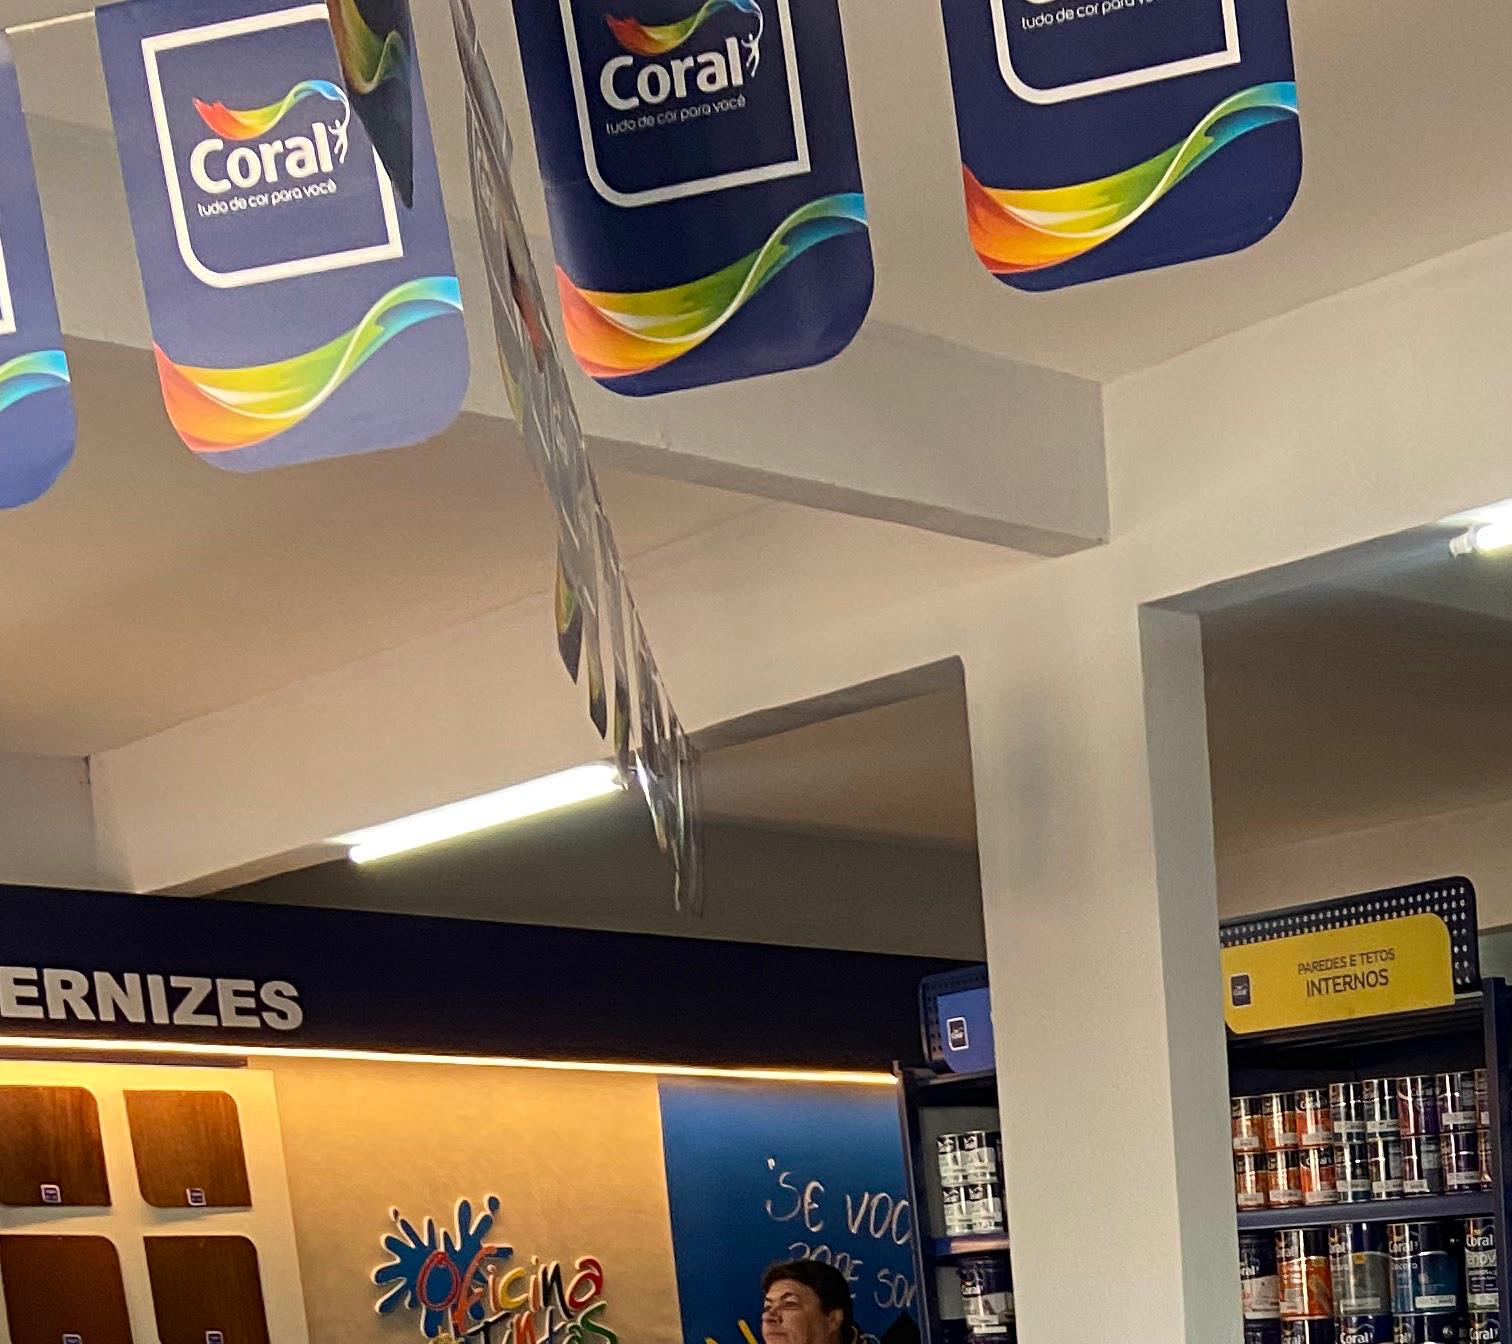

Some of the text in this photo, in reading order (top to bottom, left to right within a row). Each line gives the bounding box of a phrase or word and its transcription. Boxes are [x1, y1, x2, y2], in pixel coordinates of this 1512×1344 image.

[1022, 16, 1053, 30] tudo
[1056, 8, 1074, 21] de
[1077, 2, 1099, 18] cor
[600, 36, 743, 110] Coral
[190, 122, 333, 194] Coral
[1298, 948, 1395, 974] PAREDES E TETOS
[1307, 969, 1389, 998] INTERNOS
[0, 966, 303, 1030] ERNIZES
[846, 1191, 911, 1244] VOC
